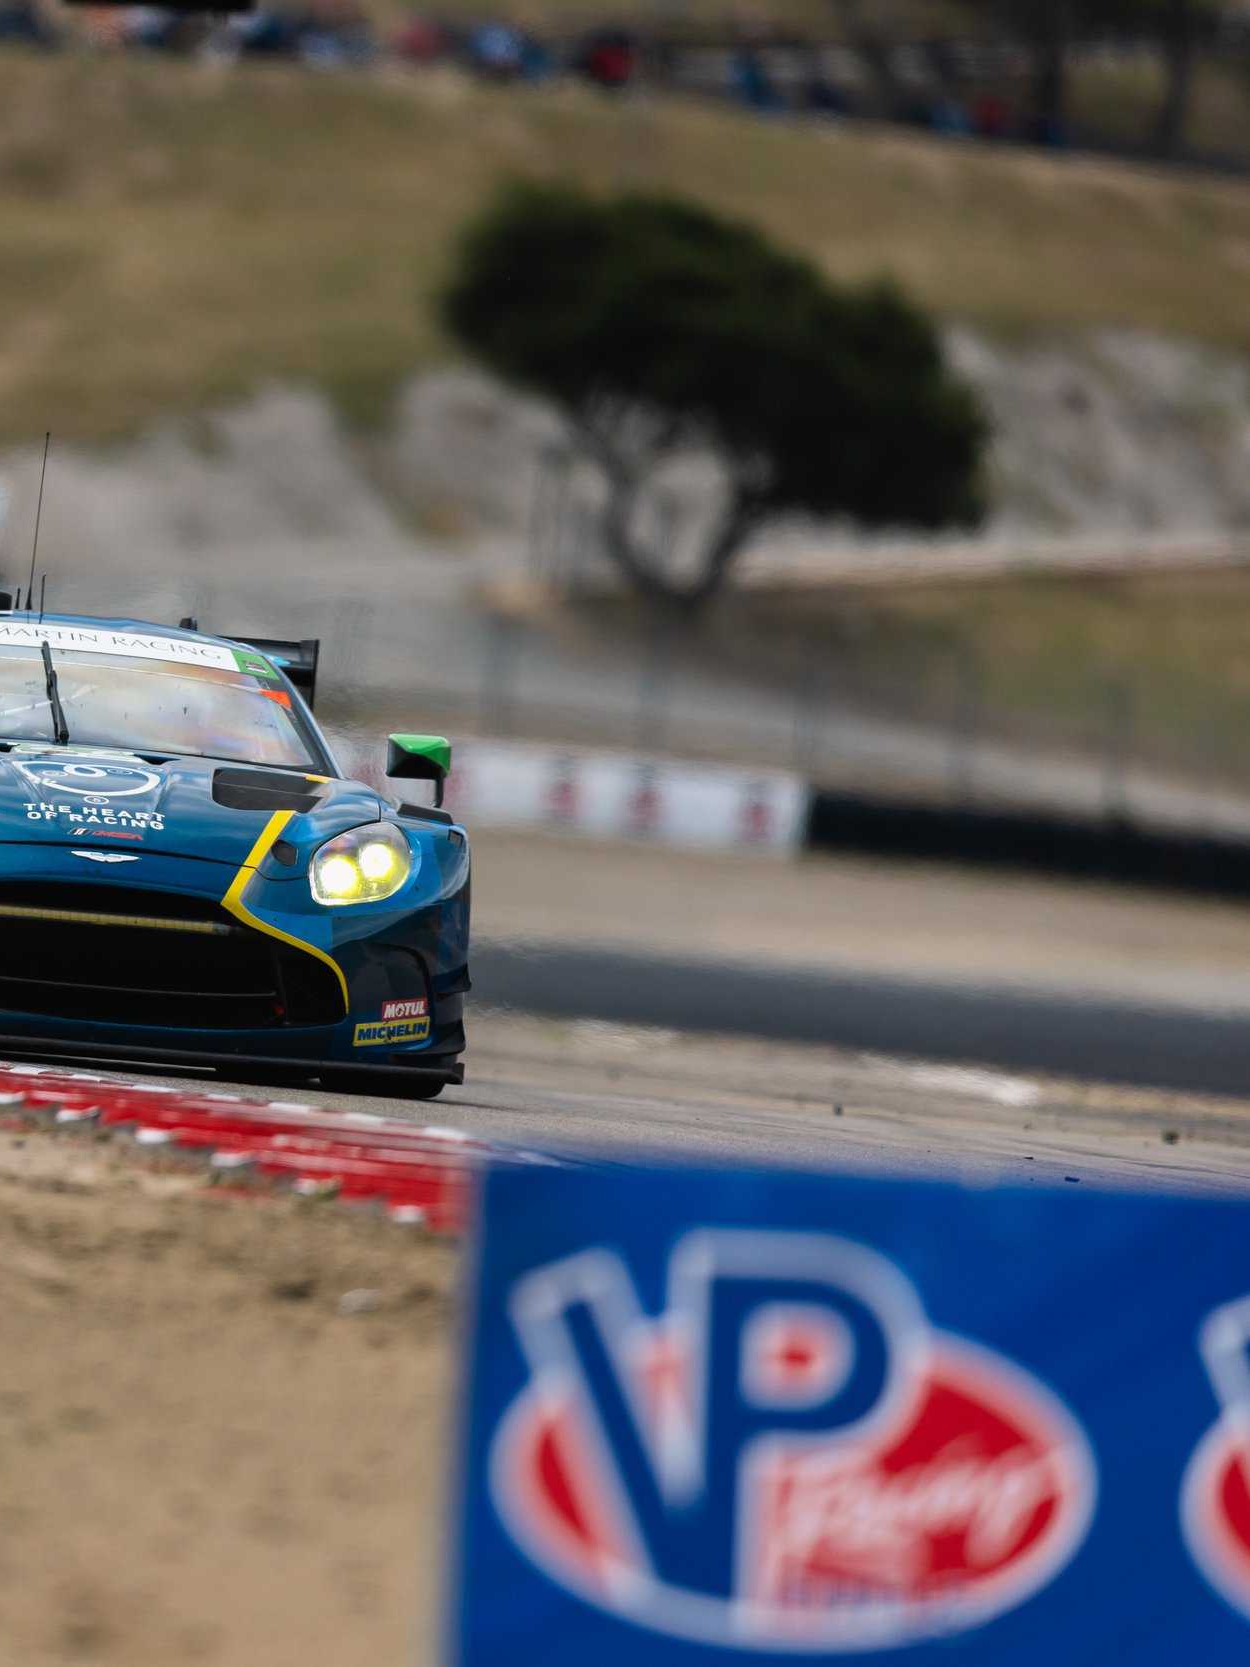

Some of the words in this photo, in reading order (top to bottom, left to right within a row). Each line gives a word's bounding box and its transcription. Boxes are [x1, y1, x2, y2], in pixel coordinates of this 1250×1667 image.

[112, 636, 222, 660] RACING
[23, 802, 71, 814] THE
[82, 806, 166, 822] HEART
[27, 811, 57, 820] OF
[69, 812, 165, 830] RACING
[383, 1001, 425, 1018] MOTUL
[357, 1022, 427, 1041] MICHELIN
[515, 1230, 920, 1615] VP
